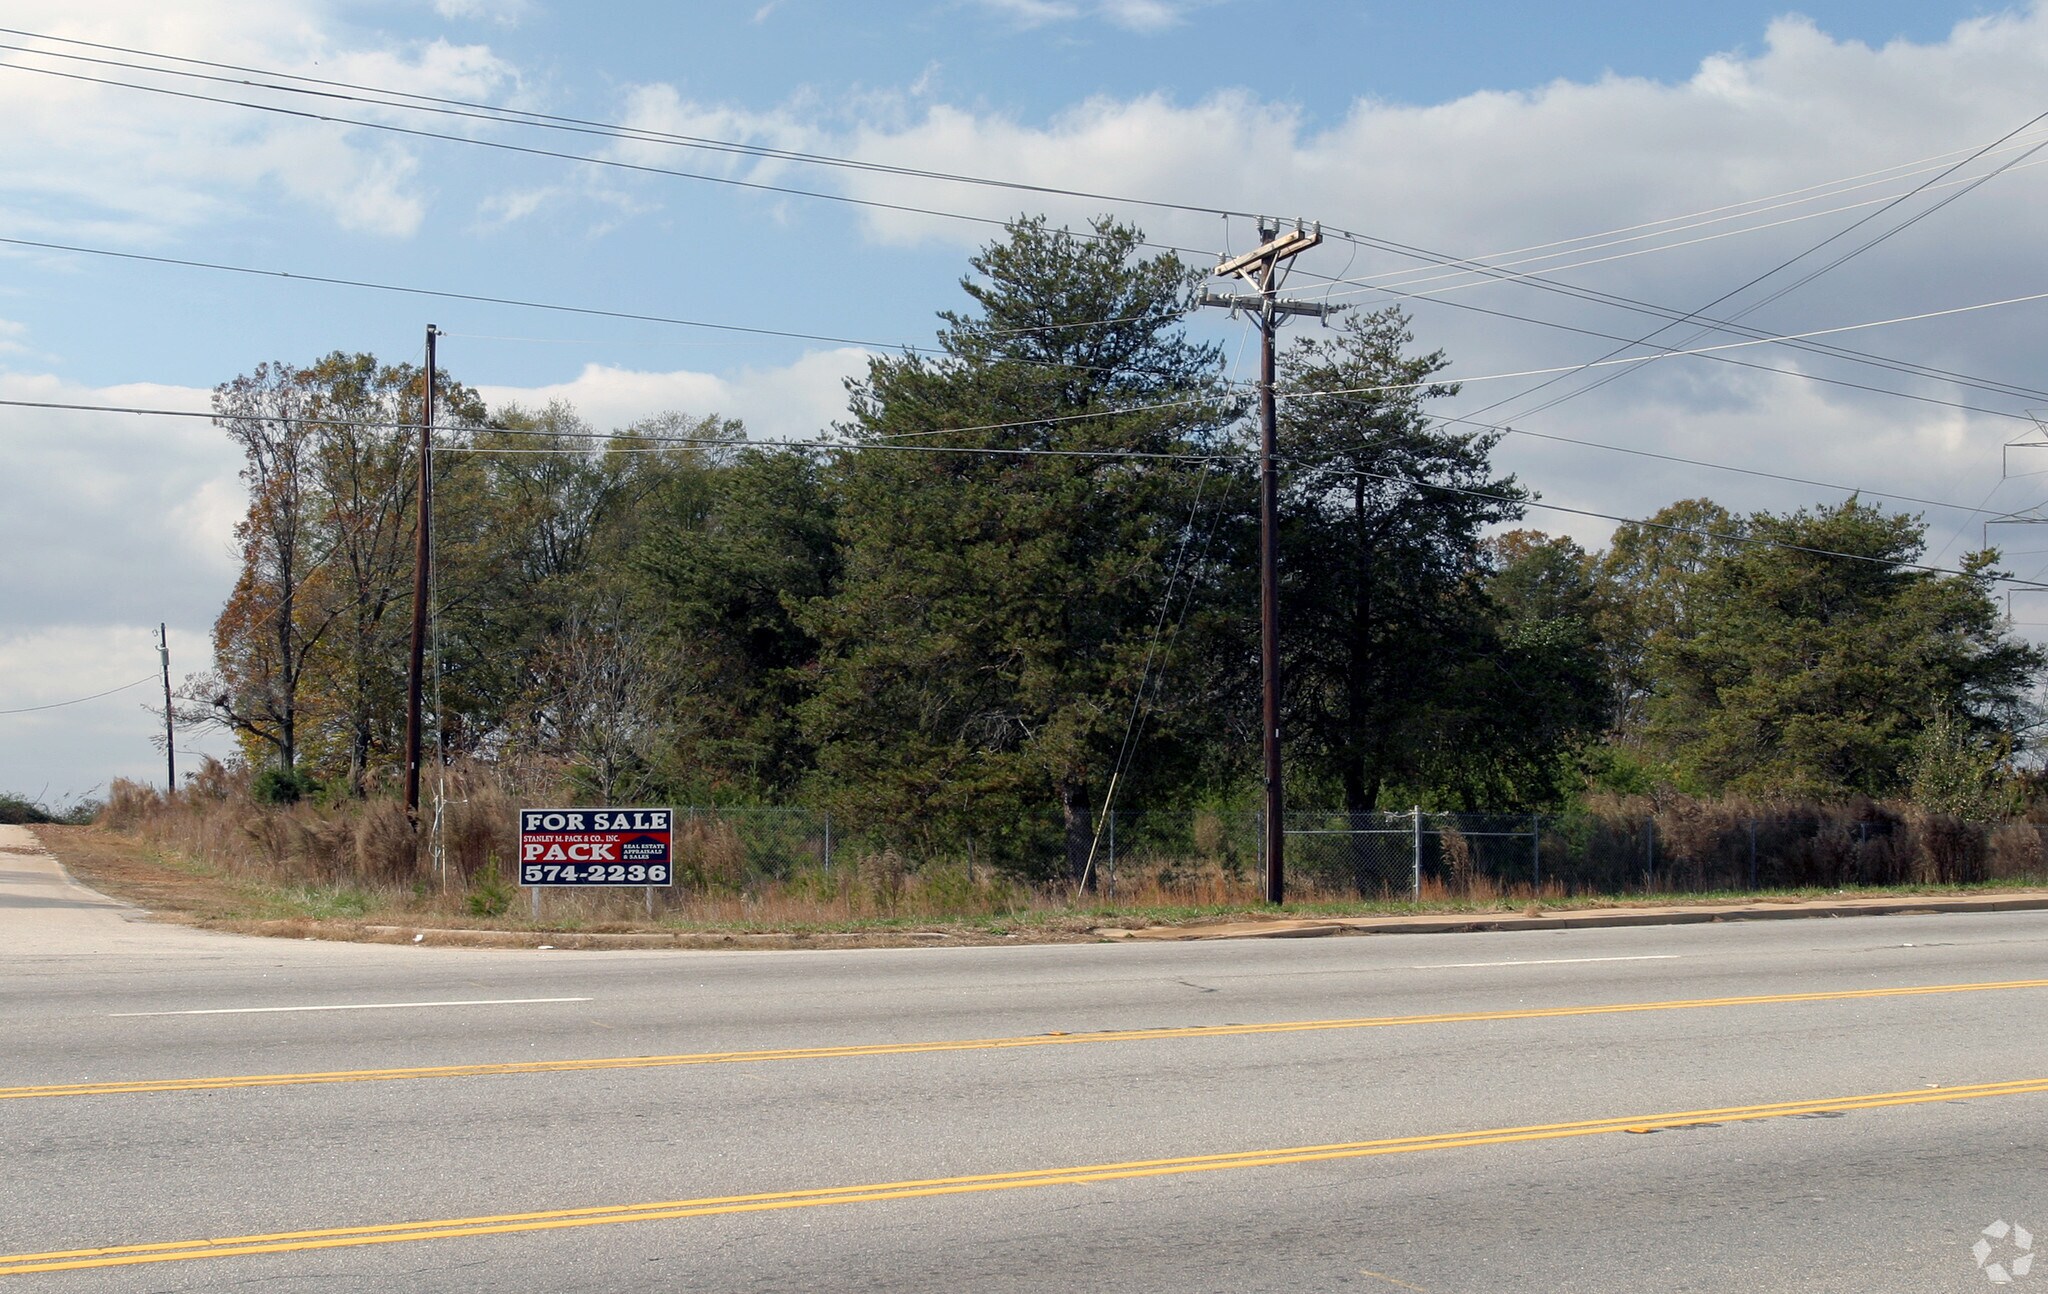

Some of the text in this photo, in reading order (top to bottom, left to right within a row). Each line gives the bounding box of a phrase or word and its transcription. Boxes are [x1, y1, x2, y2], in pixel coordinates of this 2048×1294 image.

[525, 812, 667, 831] FOR SALE
[523, 835, 554, 843] STANLEY
[555, 835, 564, 843] M.
[565, 835, 583, 843] PACK
[584, 835, 589, 843] &
[523, 843, 616, 861] PACK
[524, 864, 667, 882] 574-2236
